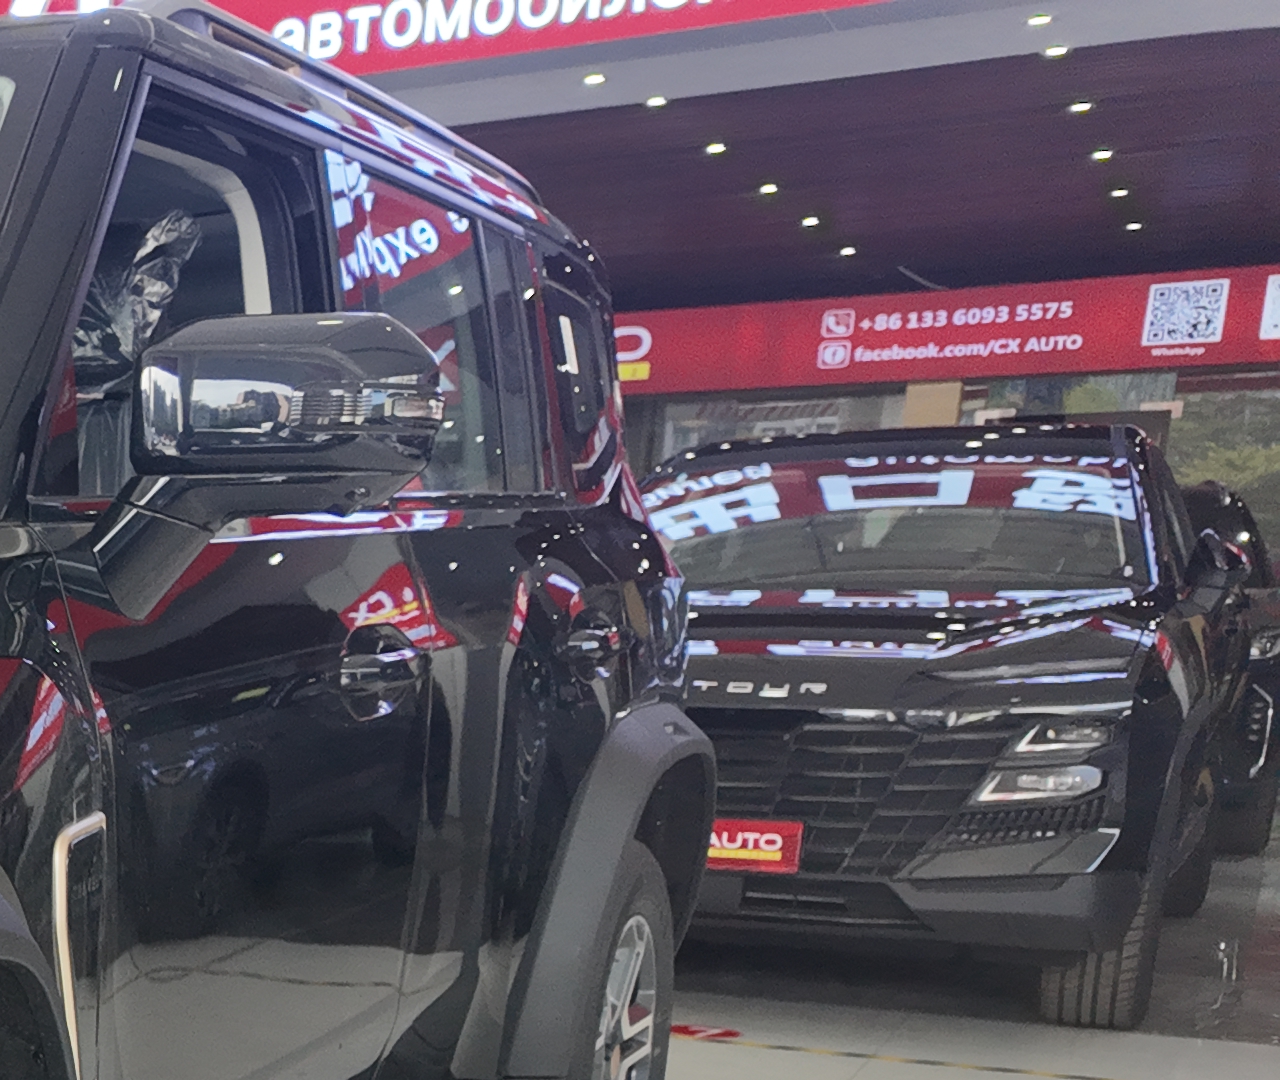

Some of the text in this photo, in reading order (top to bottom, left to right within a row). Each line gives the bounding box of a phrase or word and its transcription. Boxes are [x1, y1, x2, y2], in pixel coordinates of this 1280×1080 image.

[858, 301, 1074, 333] +86 133 6093 5575
[1024, 333, 1083, 355] AUTO
[692, 678, 829, 699] TOUR
[709, 831, 783, 852] AUTO
